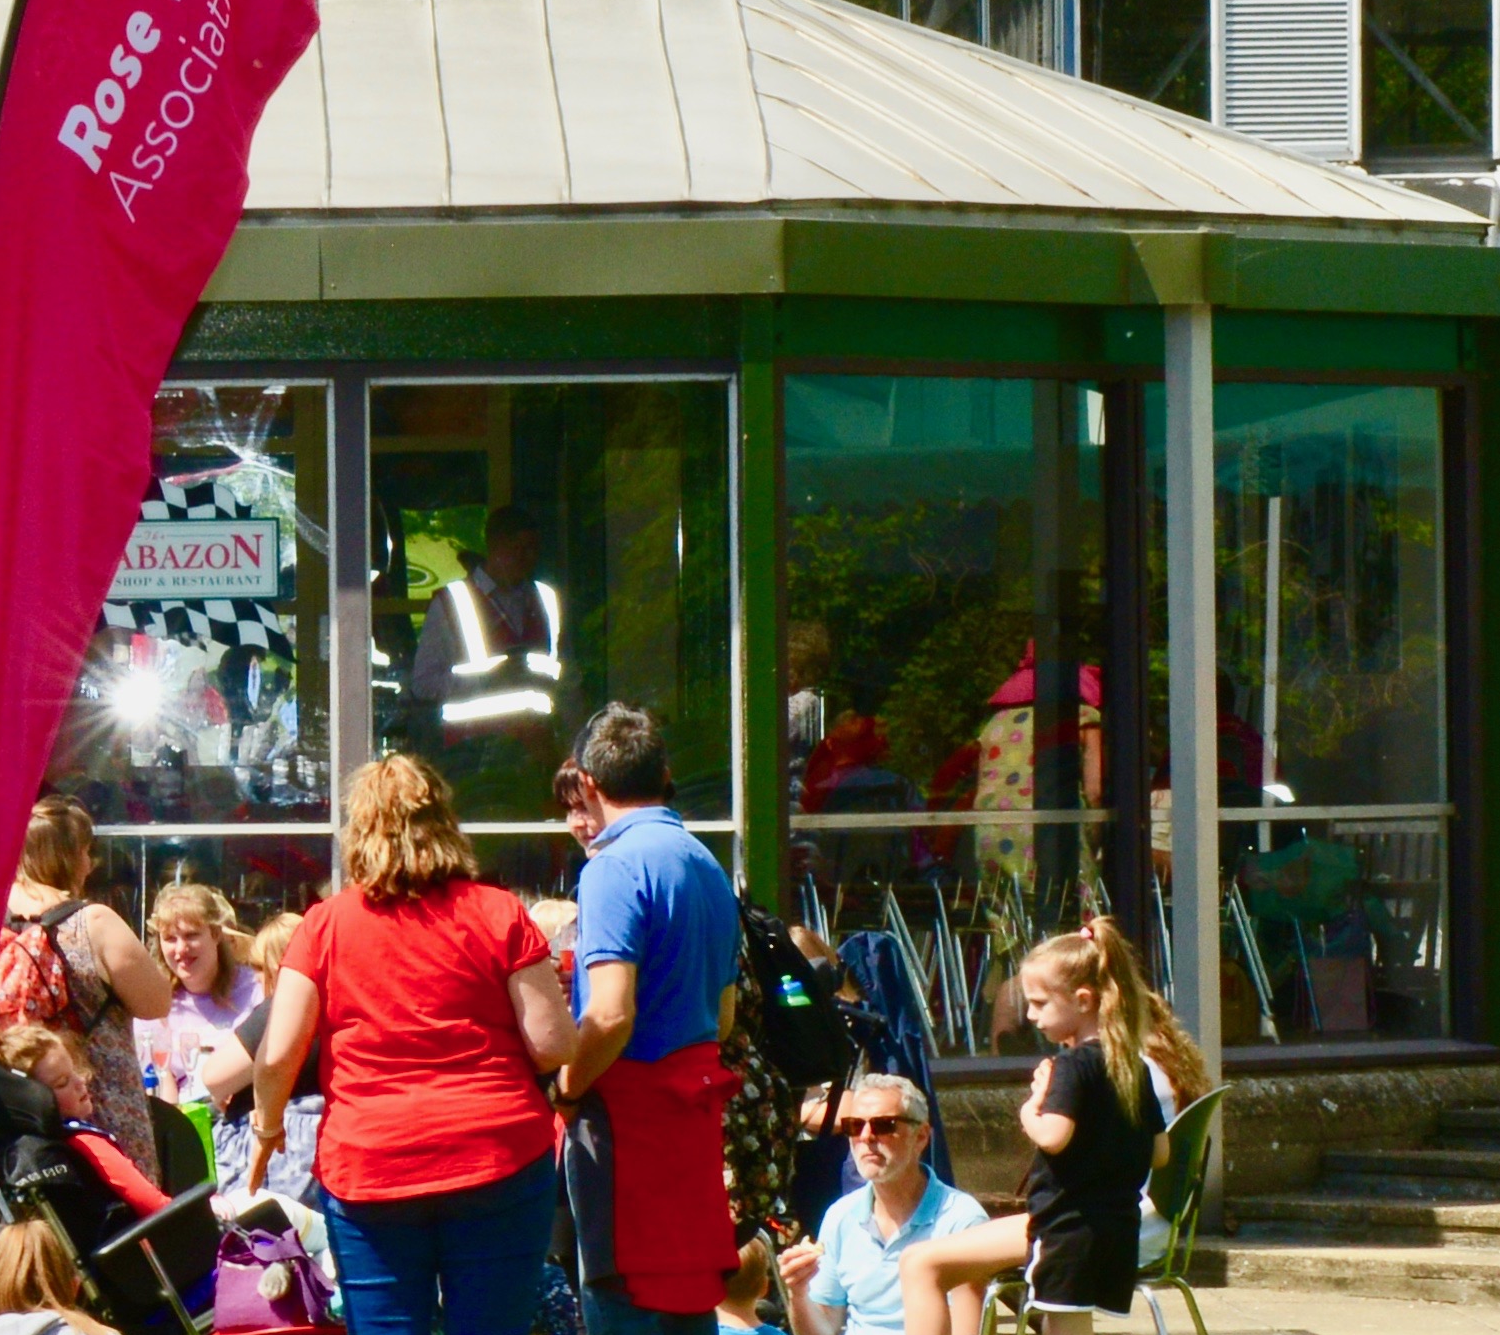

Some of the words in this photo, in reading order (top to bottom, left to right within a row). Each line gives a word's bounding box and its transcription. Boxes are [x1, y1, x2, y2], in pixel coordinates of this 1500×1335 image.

[58, 9, 160, 174] Rose
[120, 533, 264, 571] ABAZON
[115, 577, 152, 587] SHOP
[157, 576, 166, 587] &
[172, 575, 262, 587] RESTAURANT
